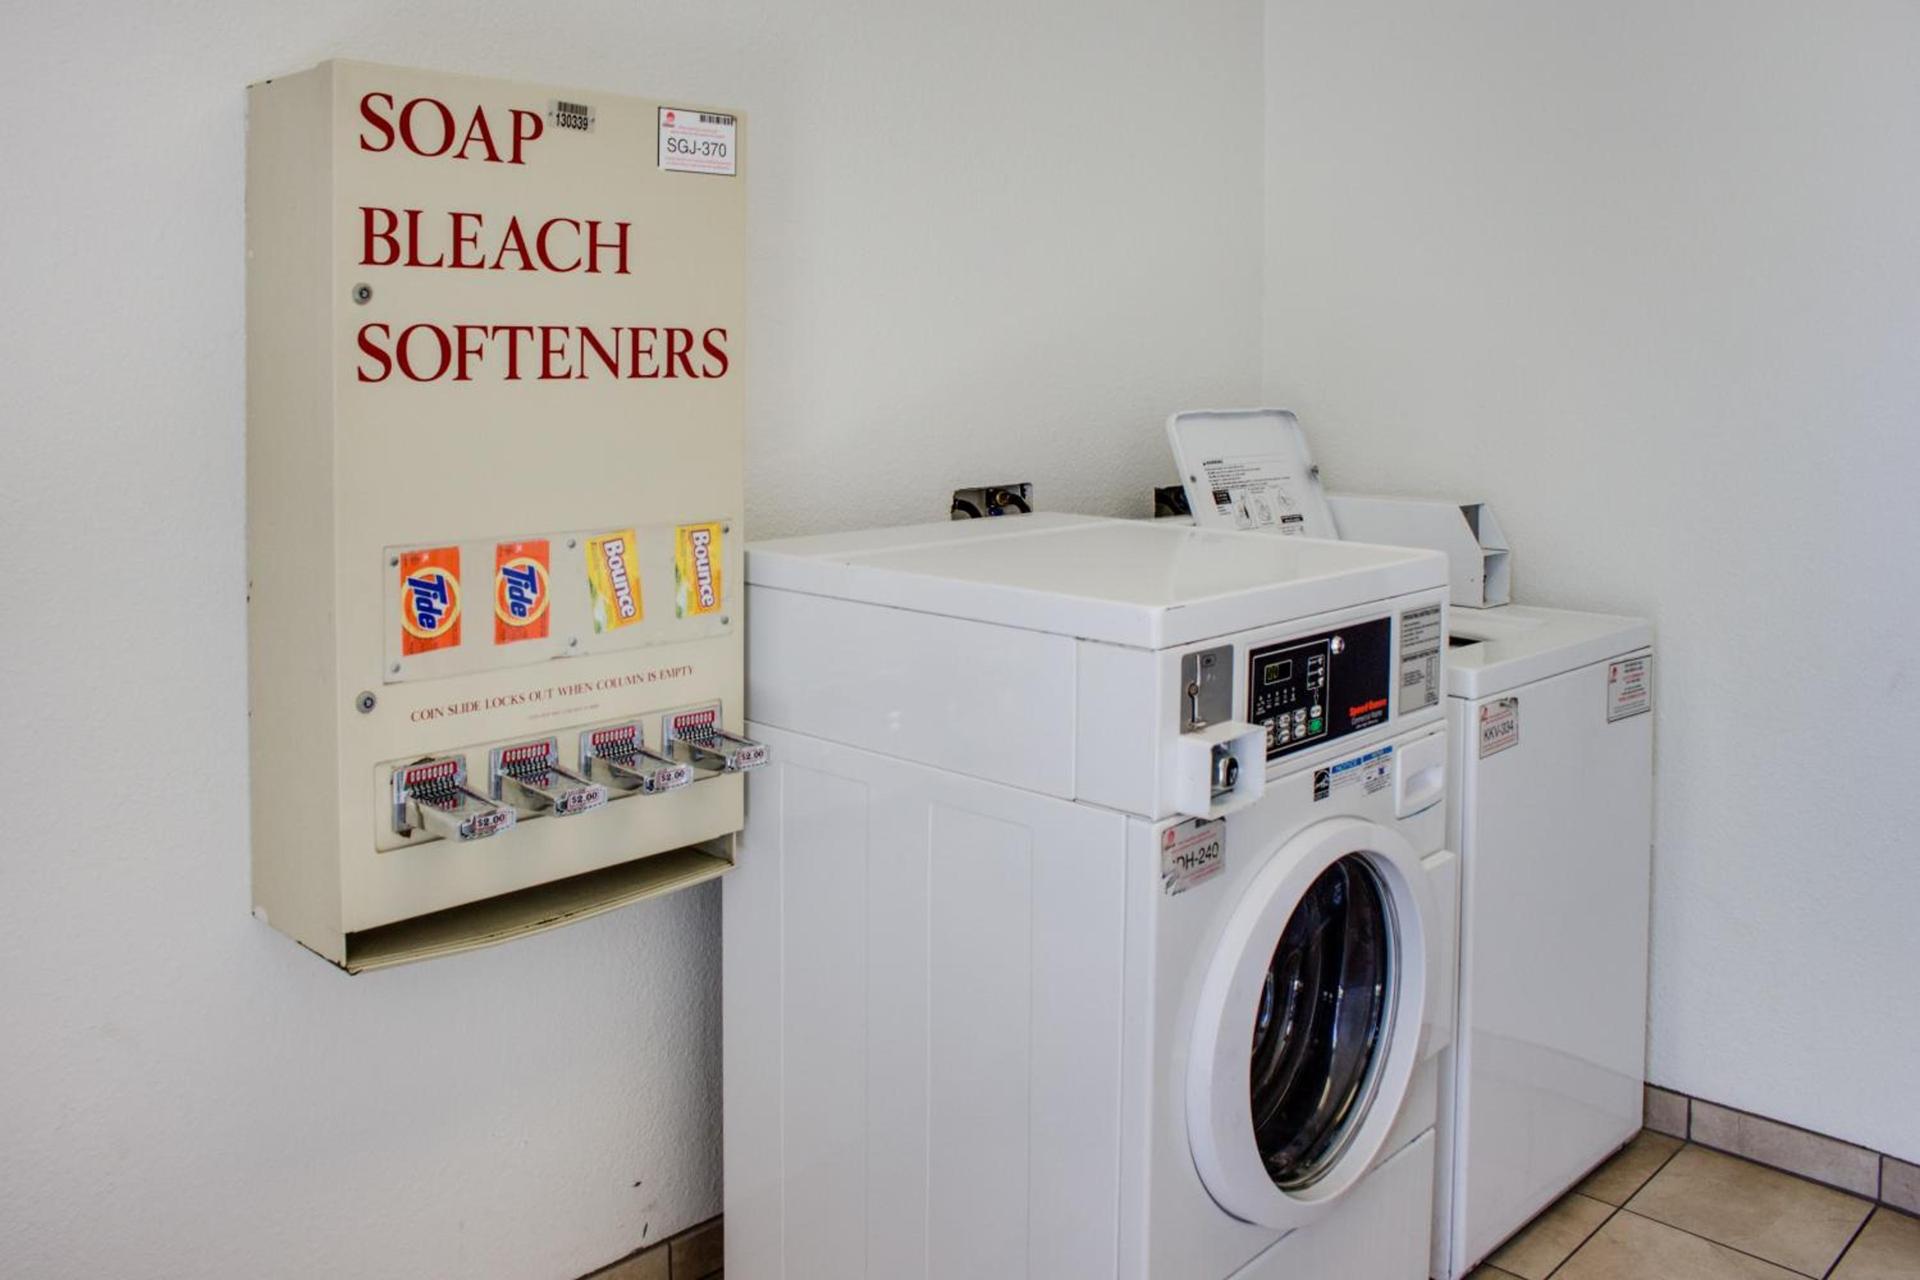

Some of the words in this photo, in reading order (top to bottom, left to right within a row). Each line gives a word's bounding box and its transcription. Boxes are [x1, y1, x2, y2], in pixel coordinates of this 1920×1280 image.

[359, 92, 544, 165] SOAP
[556, 112, 588, 131] 130339
[667, 137, 727, 158] SGJ-370
[358, 206, 632, 274] BLEACH
[356, 322, 729, 383] SOFTENERS
[501, 564, 539, 618] Tide
[603, 537, 637, 620] Bounce
[691, 528, 715, 609] Bounce
[406, 573, 449, 630] Tide
[410, 707, 444, 722] COIN
[447, 700, 481, 716] SLIDE
[484, 694, 525, 711] LOCKS
[528, 688, 554, 702] OUT
[557, 682, 594, 697] WHEN
[596, 673, 646, 691] COLUMN
[647, 671, 658, 683] IS
[660, 665, 694, 681] EMPTY
[661, 769, 685, 782] $2.00
[741, 750, 764, 761] $2.00
[477, 813, 505, 827] $2.00
[571, 791, 598, 804] $2.00
